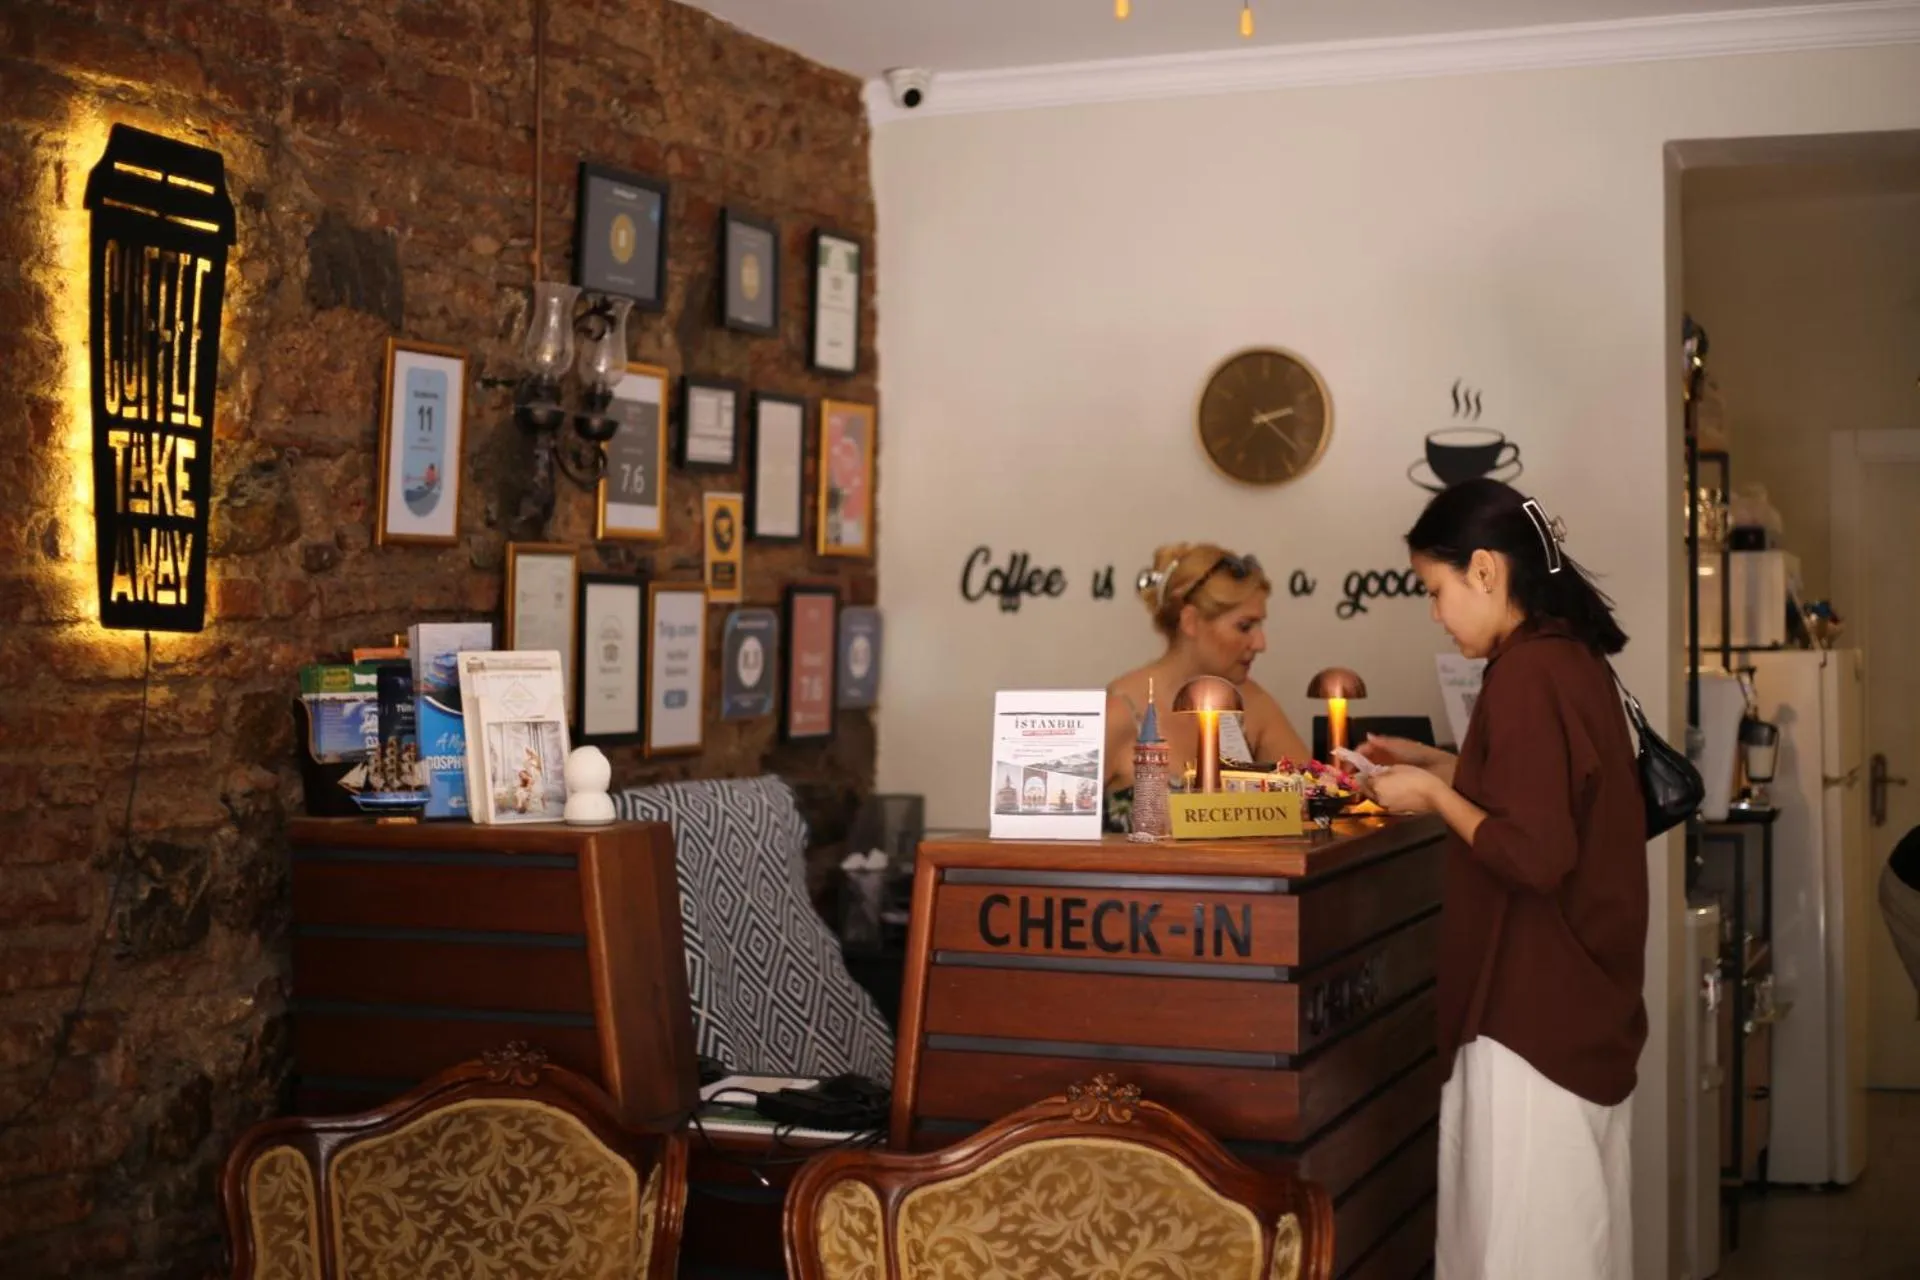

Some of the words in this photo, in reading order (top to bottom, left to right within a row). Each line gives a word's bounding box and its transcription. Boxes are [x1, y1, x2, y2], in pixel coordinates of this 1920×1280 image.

[104, 239, 212, 428] COFFEE
[418, 404, 433, 432] 11
[108, 429, 196, 518] TAKE
[109, 521, 193, 606] AWAY
[961, 545, 1067, 612] Coffee
[1289, 568, 1317, 597] a
[1015, 715, 1085, 729] İSTANBUL
[1184, 806, 1290, 824] RECEPTION
[978, 892, 1253, 958] CHECK-IN
